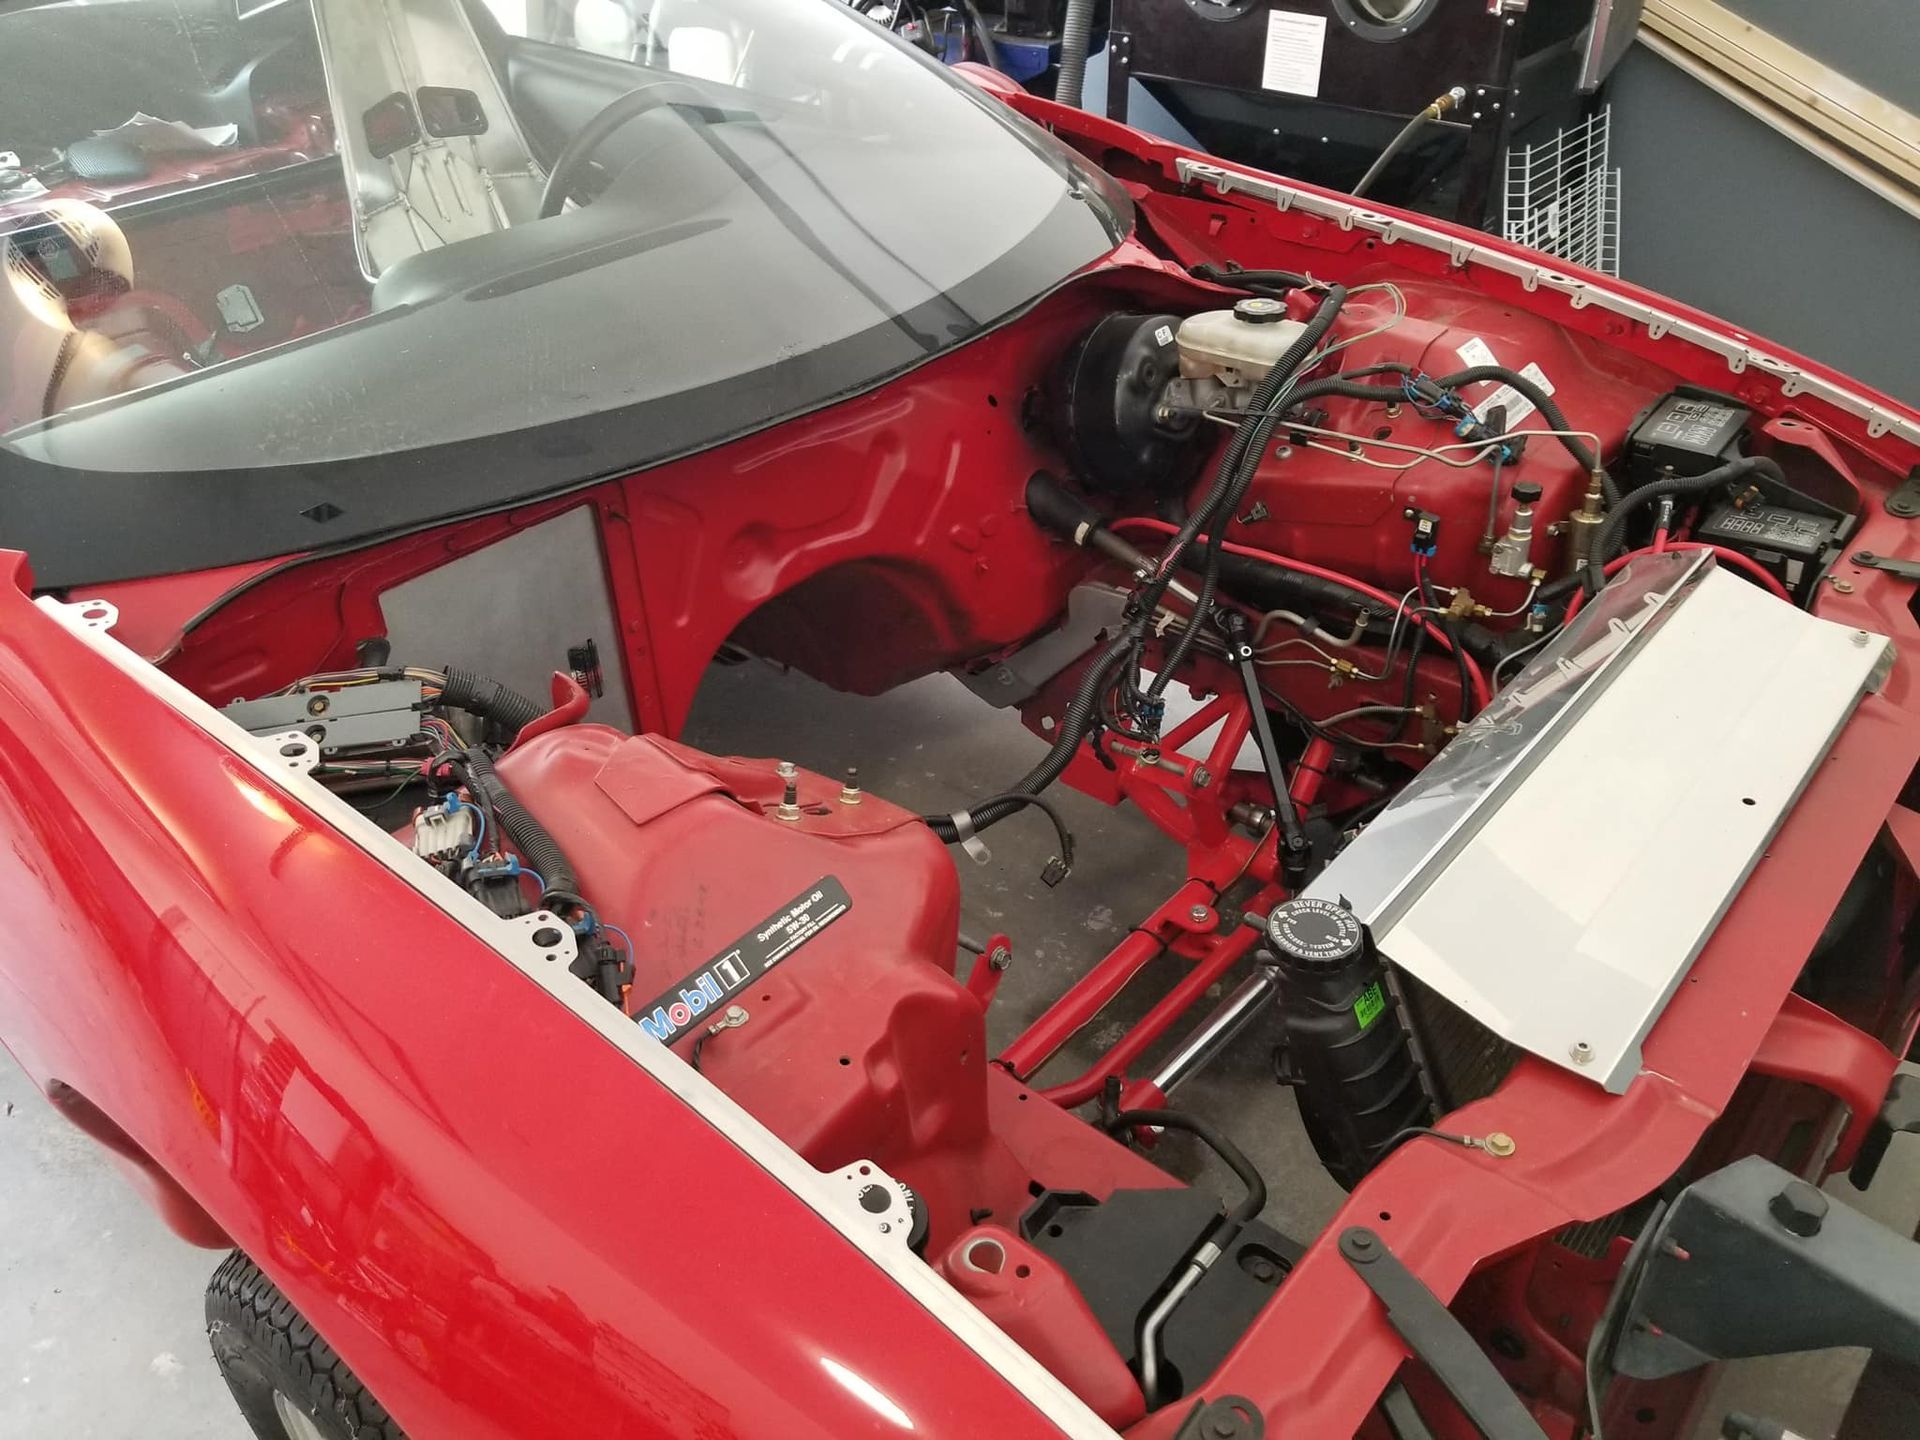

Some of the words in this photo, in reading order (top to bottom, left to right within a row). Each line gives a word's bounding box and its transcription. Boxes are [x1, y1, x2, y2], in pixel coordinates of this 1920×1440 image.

[757, 915, 792, 942] Synthetic
[790, 899, 812, 918] Motor
[811, 890, 824, 902] Oil
[786, 913, 811, 934] 5W-30
[1290, 908, 1310, 916] CHECK
[1312, 908, 1331, 917] LEVEL
[1292, 900, 1323, 909] NEVER
[1325, 904, 1346, 919] OPEN
[1344, 918, 1357, 932] HOT
[639, 972, 724, 1041] Mobil
[722, 959, 742, 984] 1
